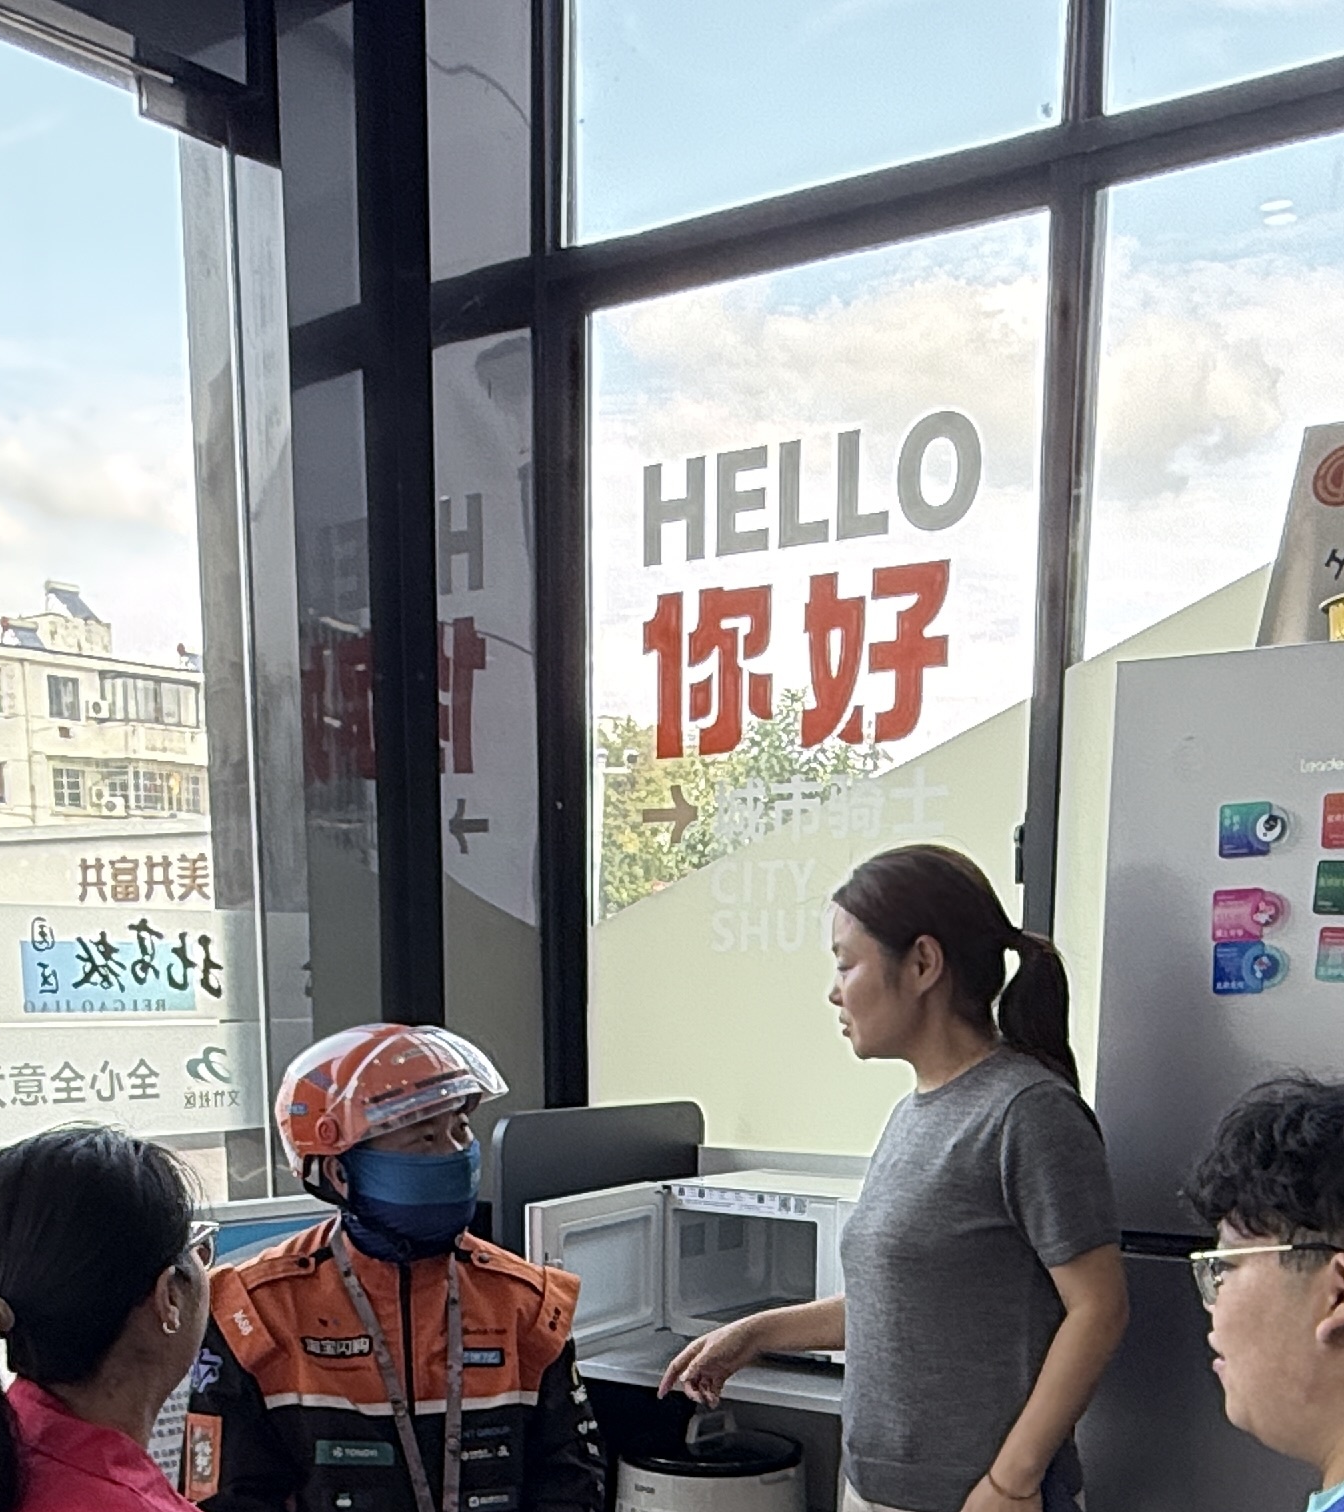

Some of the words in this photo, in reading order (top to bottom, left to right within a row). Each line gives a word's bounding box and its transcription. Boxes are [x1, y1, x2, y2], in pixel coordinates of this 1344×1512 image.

[642, 410, 982, 567] HELLO
[642, 558, 952, 760] 你好
[711, 859, 818, 905] CITY
[711, 909, 823, 952] SHU
